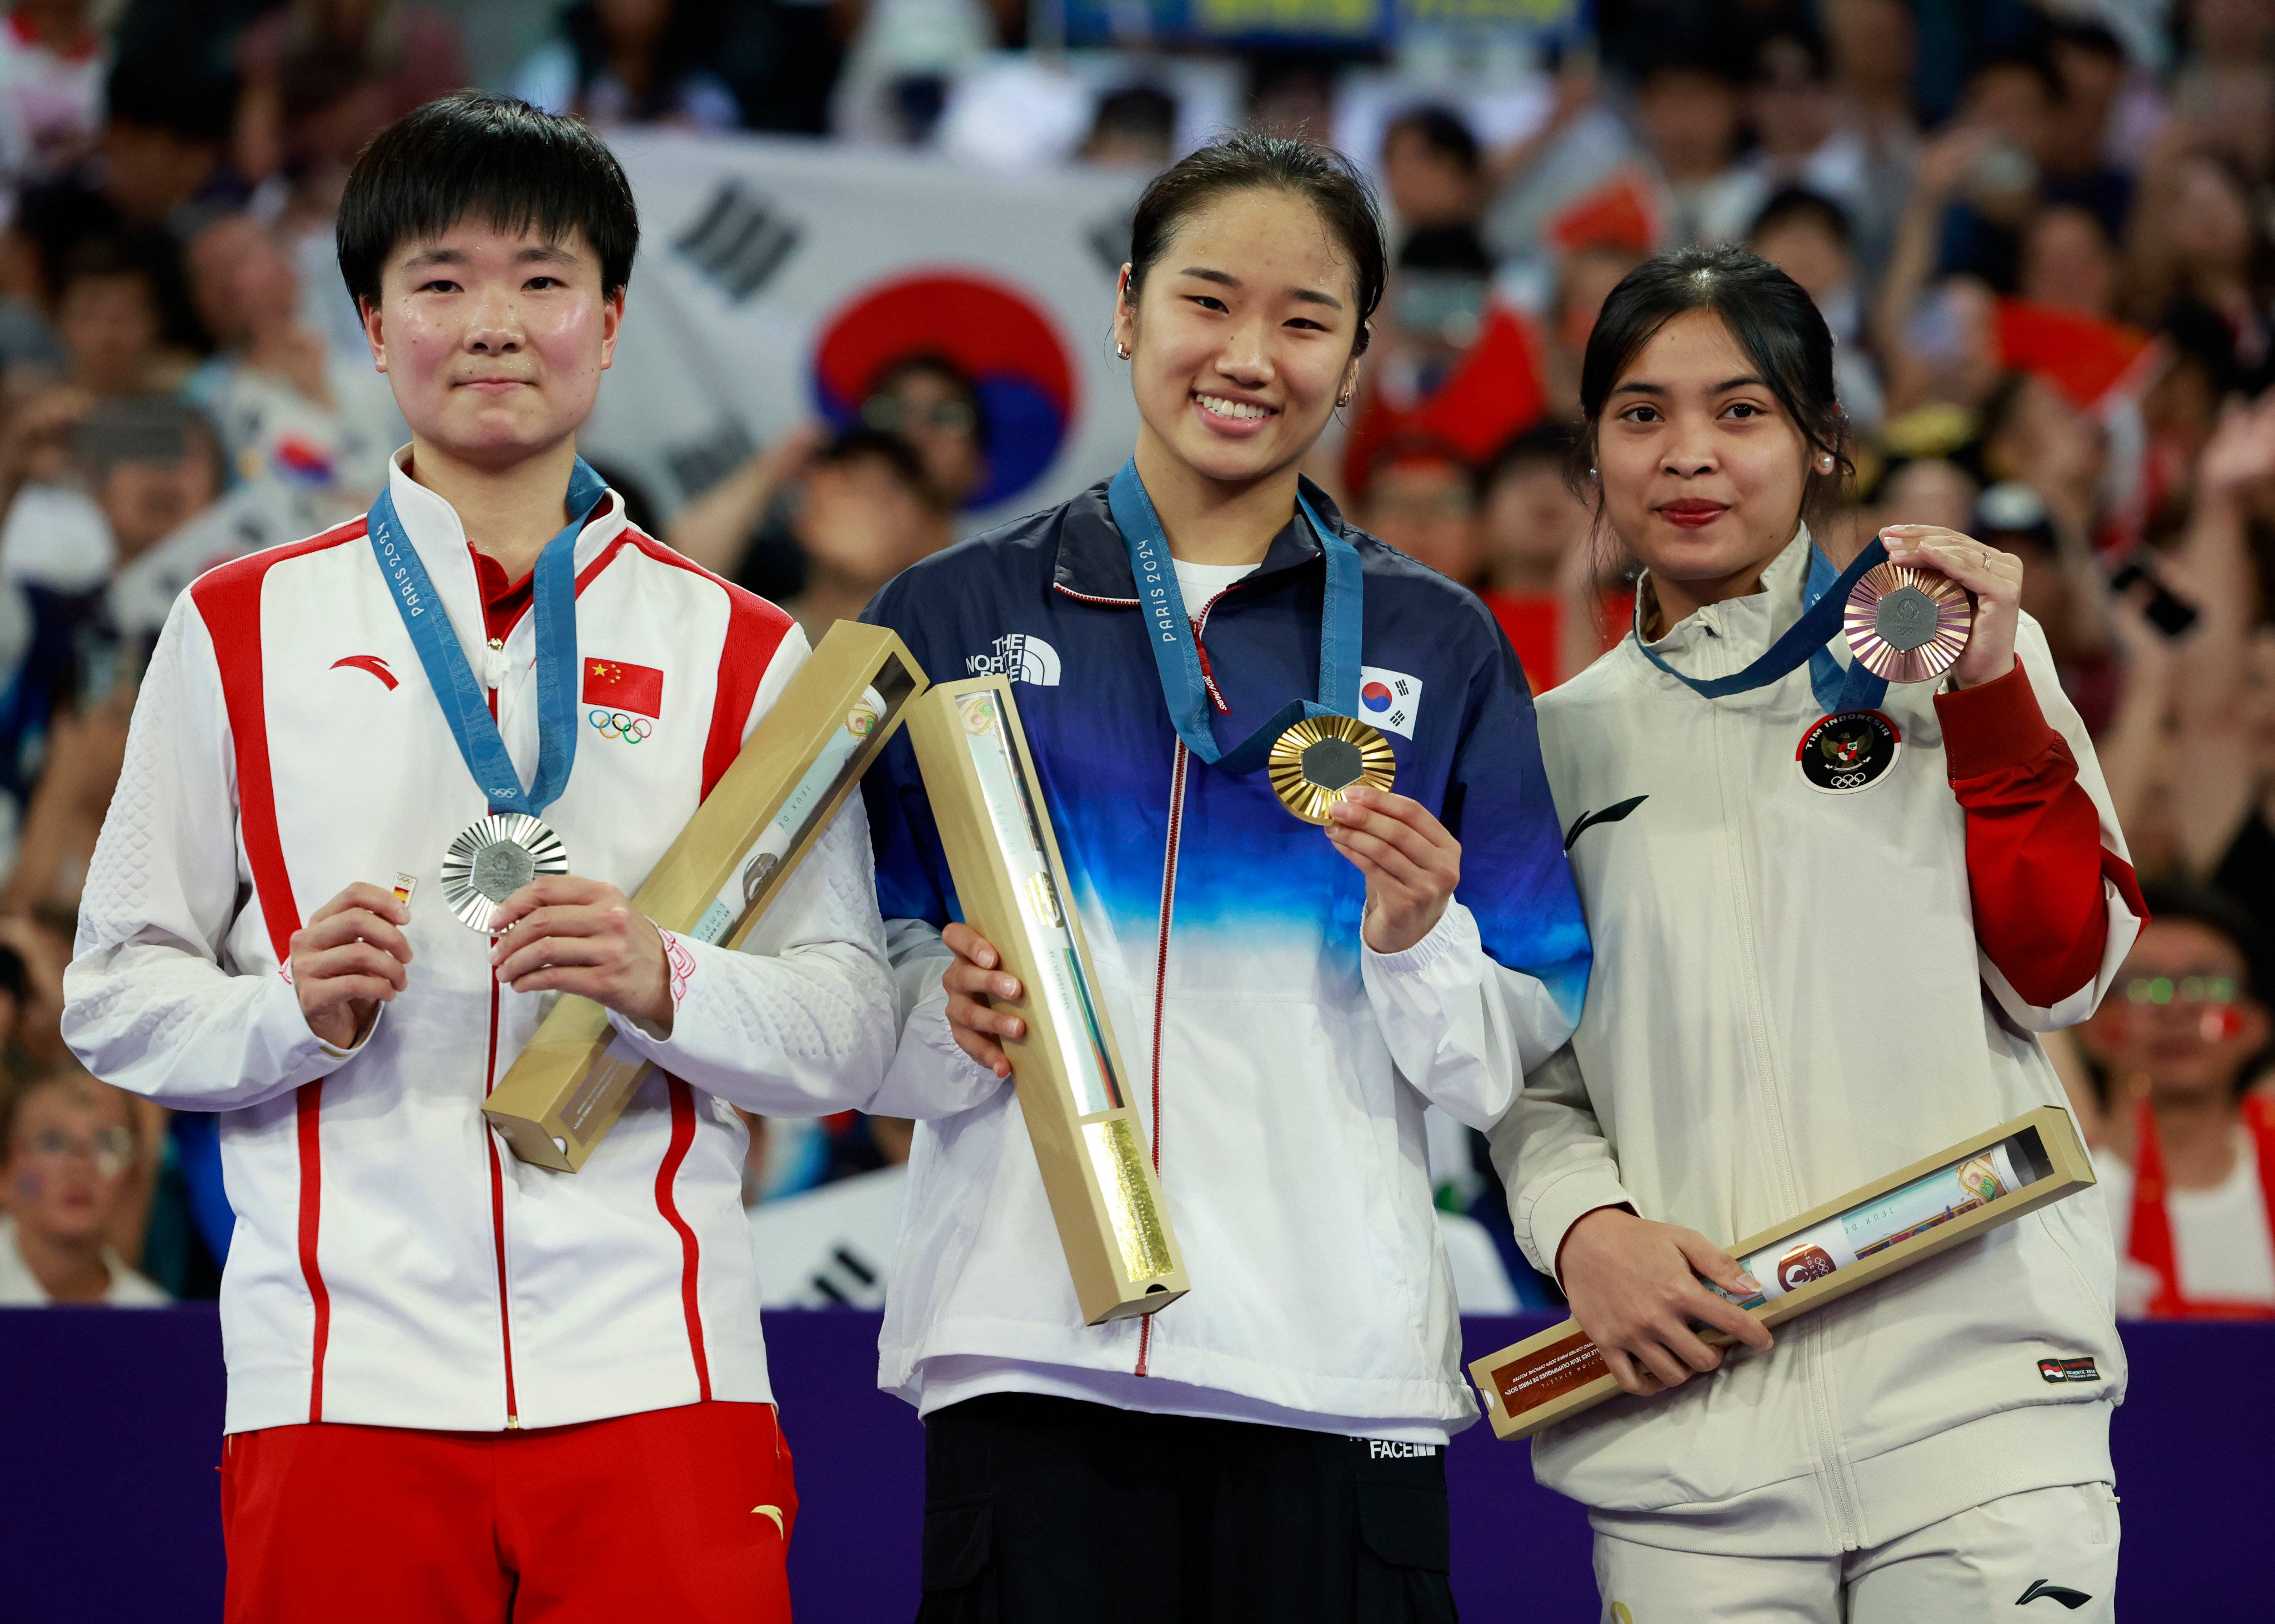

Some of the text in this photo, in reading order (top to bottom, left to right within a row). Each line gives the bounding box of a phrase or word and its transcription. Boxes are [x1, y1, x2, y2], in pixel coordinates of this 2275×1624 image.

[377, 522, 401, 567] 2024
[1138, 539, 1161, 583] 2024
[992, 634, 1024, 656] THE
[965, 650, 1023, 675] NORTH
[1202, 675, 1227, 710] 2024 PARIS
[1805, 714, 1890, 750] TIM INDONESIA
[791, 785, 811, 811] JEUX
[995, 804, 1009, 833] JEUX
[697, 903, 725, 940] LYMPI
[1062, 993, 1070, 1009] 2024
[1844, 1207, 1893, 1234] JEUX DE
[1804, 1251, 1815, 1269] 2024
[1556, 1352, 1569, 1361] PARIS
[1568, 1346, 1583, 1356] GAMES
[1581, 1352, 1591, 1360] DES
[1527, 1364, 1546, 1375] OFFICIAL
[1545, 1358, 1557, 1367] 2024
[1569, 1356, 1581, 1365] JEUX
[1511, 1372, 1528, 1382] POSTER
[1539, 1361, 1570, 1380] OLYMPIQUES
[1504, 1386, 1518, 1396] 2024
[1517, 1379, 1532, 1390] PARIS
[1370, 1440, 1413, 1458] FACE
